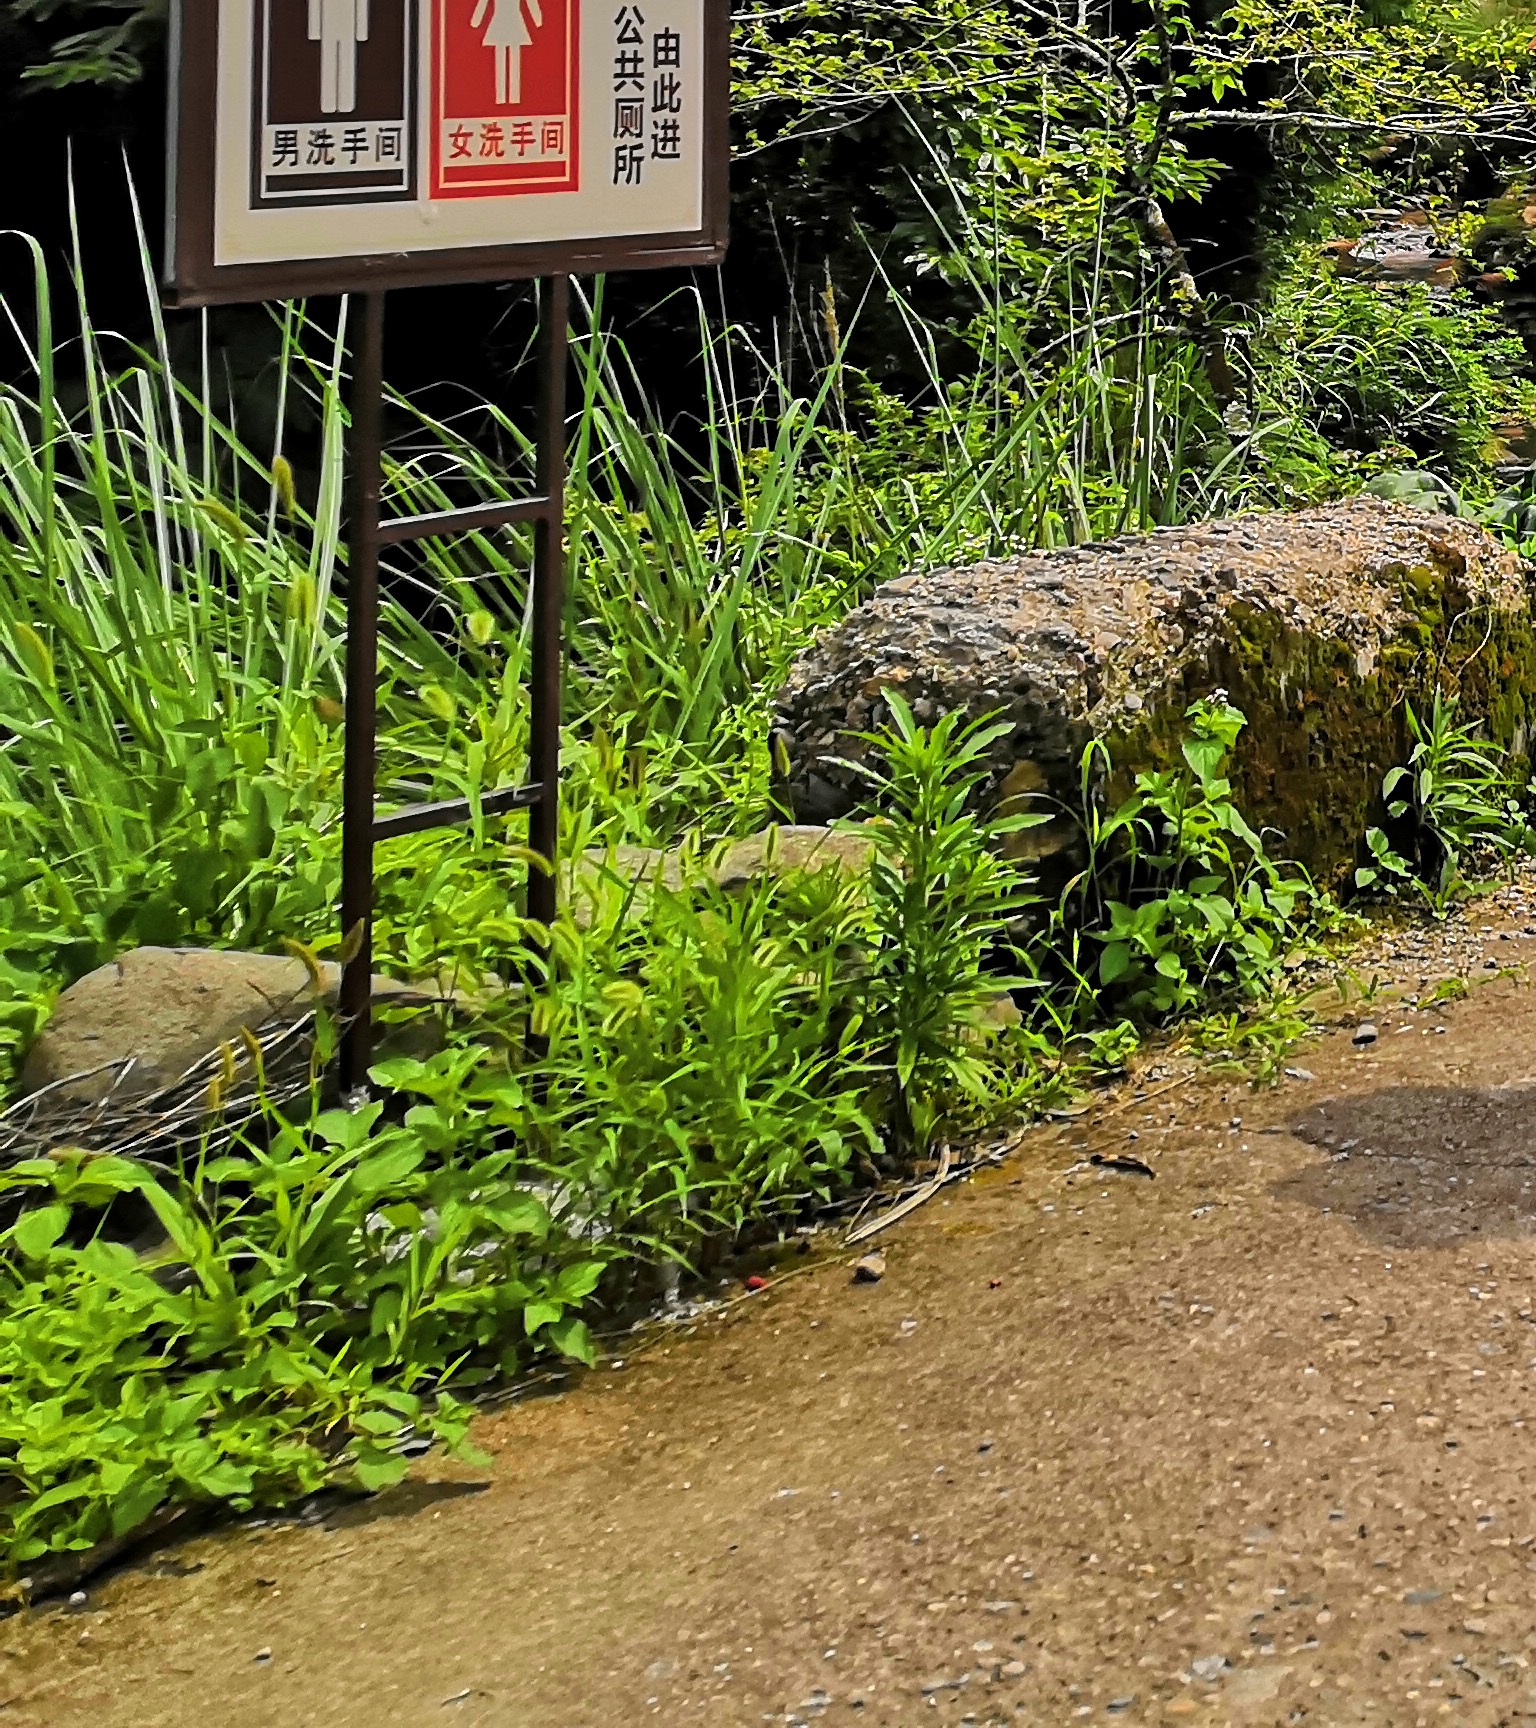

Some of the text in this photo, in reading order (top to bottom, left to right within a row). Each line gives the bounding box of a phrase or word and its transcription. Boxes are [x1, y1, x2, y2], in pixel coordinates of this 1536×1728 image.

[611, 4, 646, 186] 公共厕所
[650, 27, 682, 162] 由此进
[271, 126, 403, 168] 男洗手间
[447, 119, 565, 160] 女洗手间
